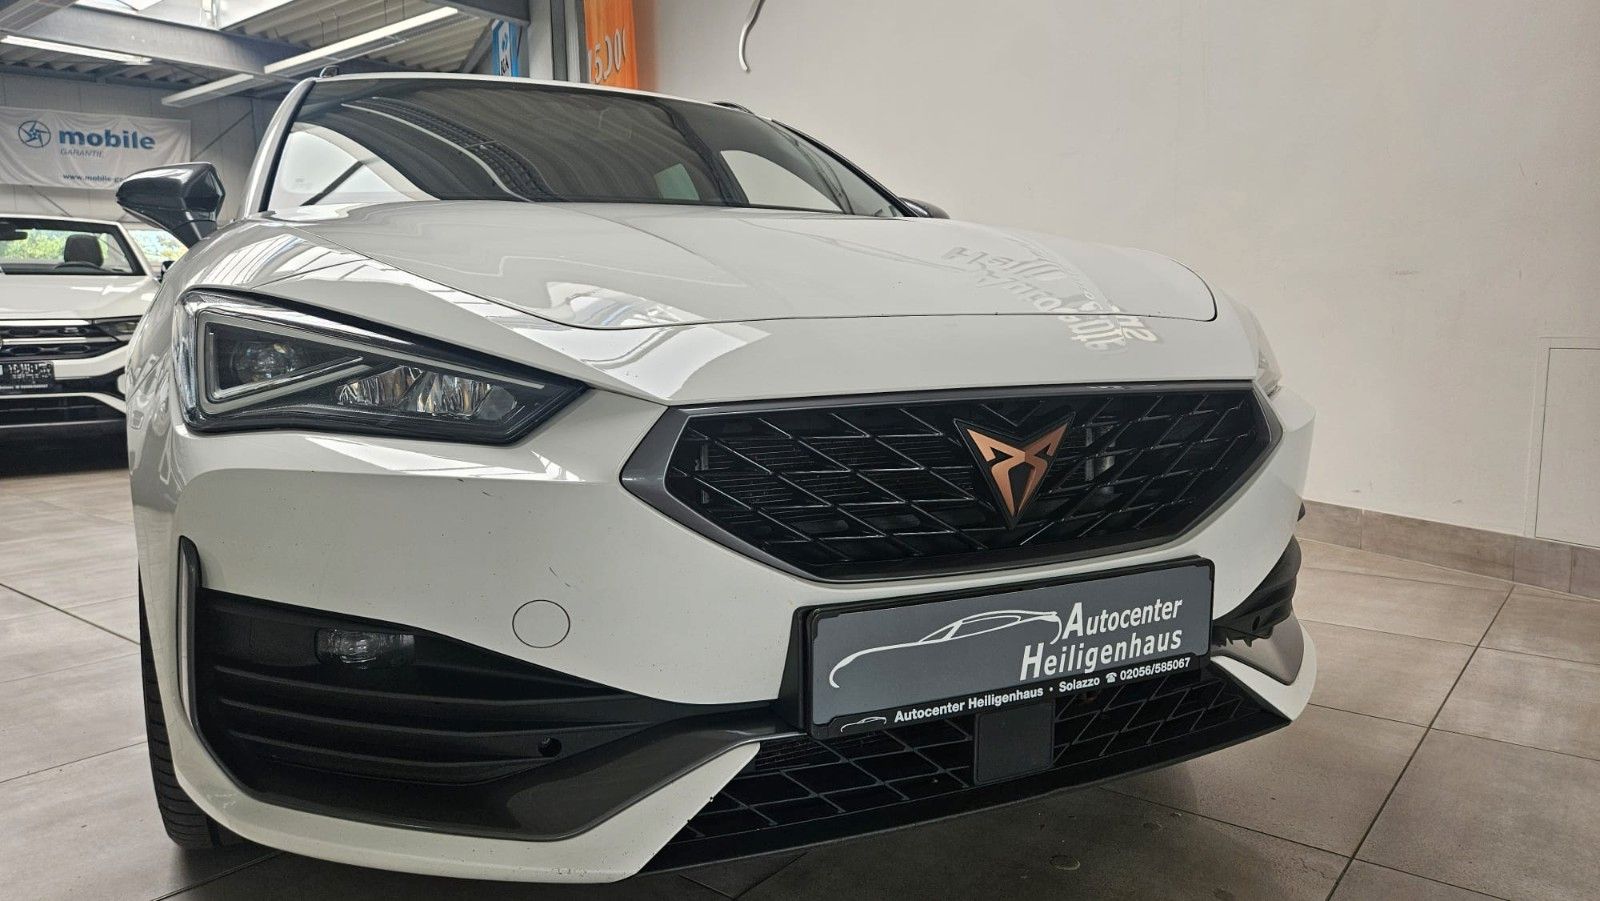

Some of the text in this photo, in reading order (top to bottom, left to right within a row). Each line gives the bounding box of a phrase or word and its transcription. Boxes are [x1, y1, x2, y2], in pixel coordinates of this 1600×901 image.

[59, 129, 155, 149] mobile
[1062, 598, 1183, 640] Autocenter
[1019, 629, 1182, 681] Heiligenhaus
[894, 657, 1191, 723] Autocenter Heiligenhaus Solazzo 02056/585067
